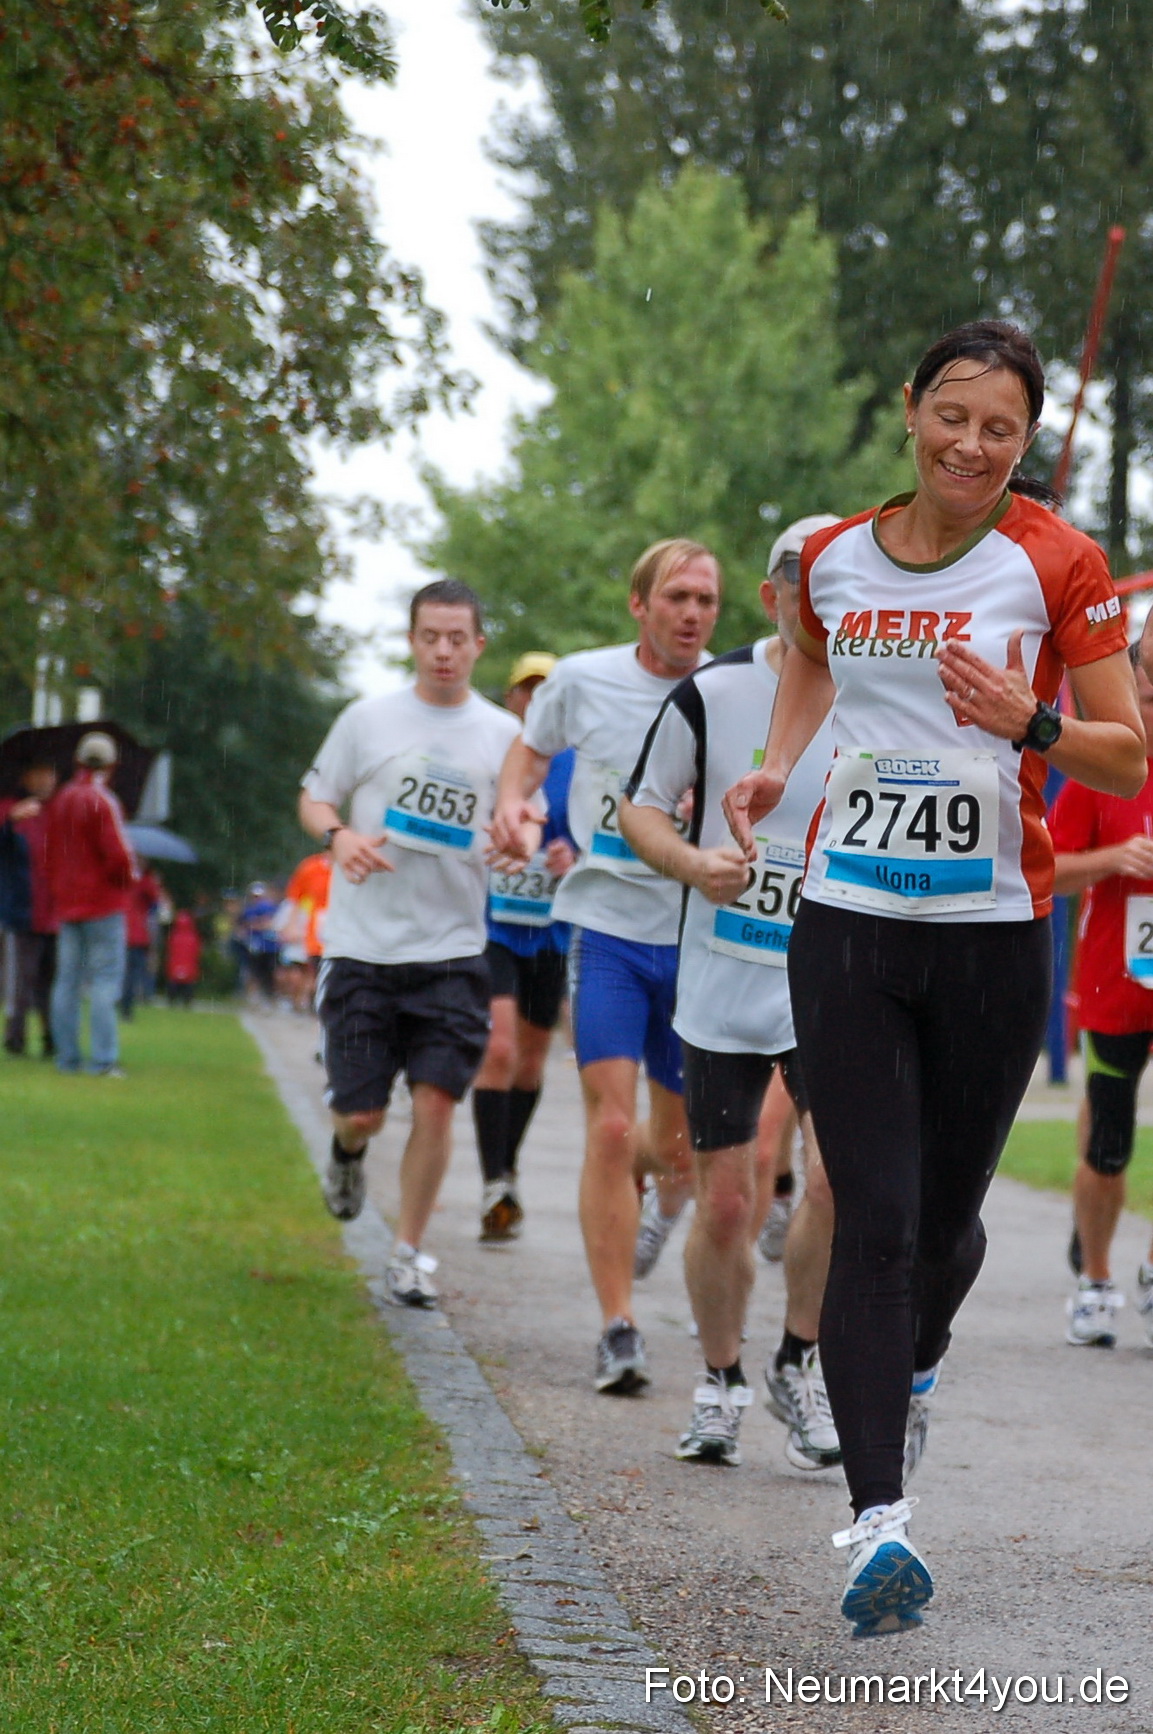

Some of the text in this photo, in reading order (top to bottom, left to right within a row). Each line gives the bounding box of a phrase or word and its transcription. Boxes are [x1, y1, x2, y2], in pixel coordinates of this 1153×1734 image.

[838, 609, 973, 641] MERZ
[832, 627, 939, 659] Reisen
[875, 758, 941, 776] BOCK
[397, 776, 478, 826] 2653
[842, 789, 981, 854] 2749
[876, 865, 931, 891] Ilona
